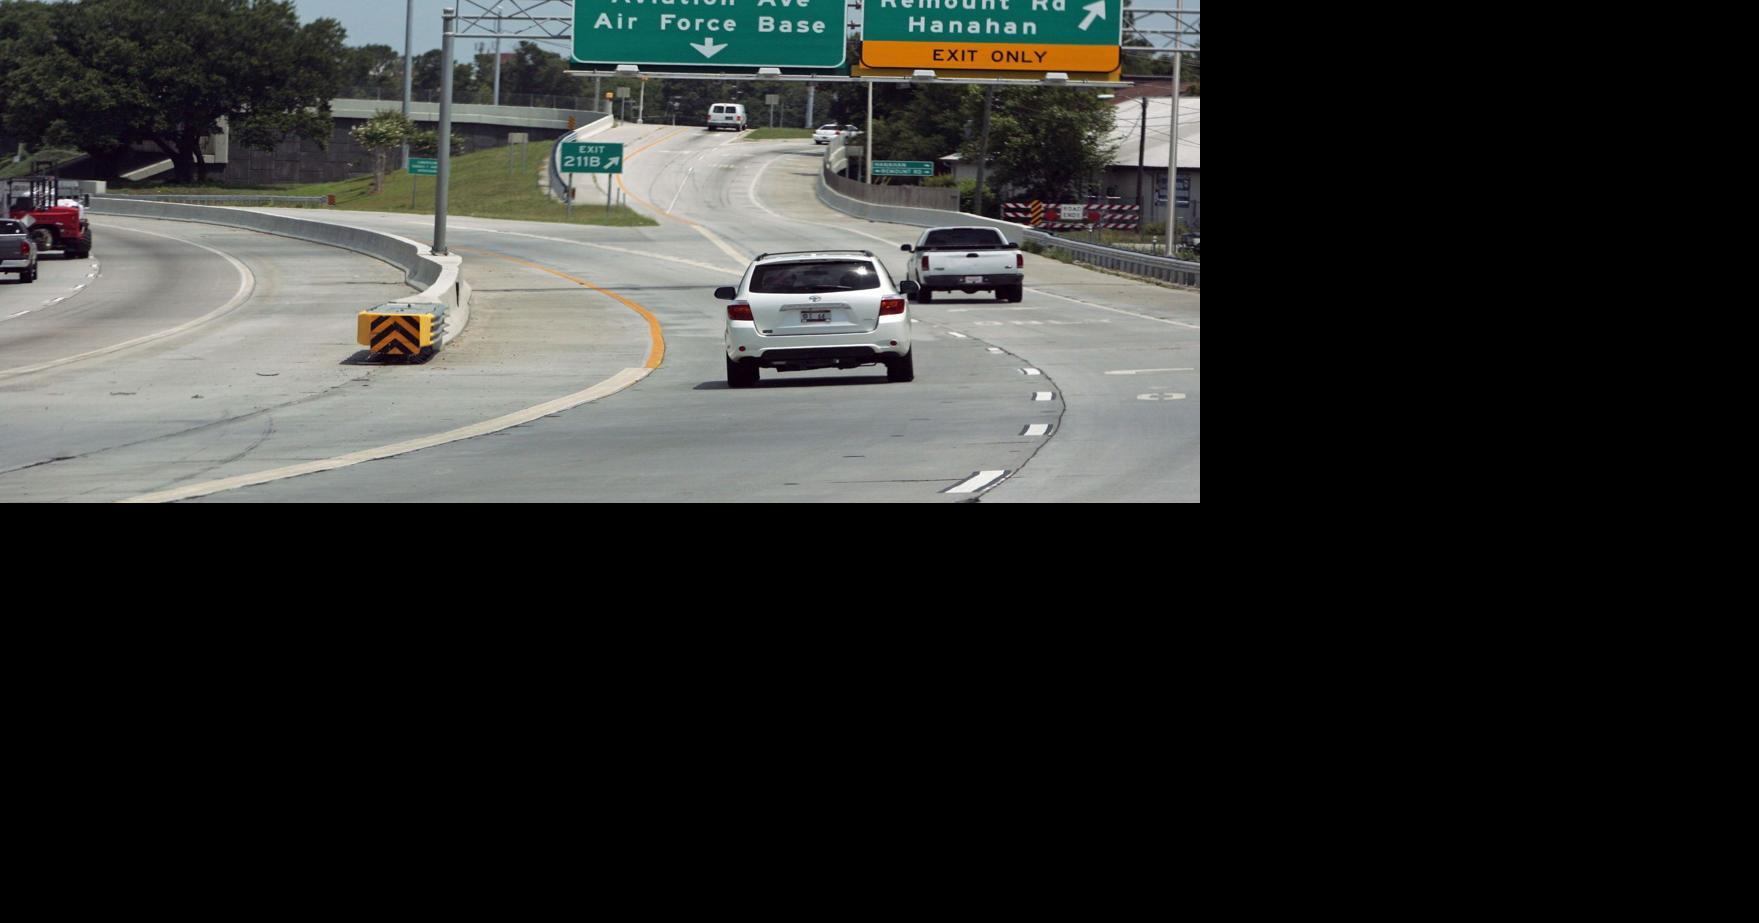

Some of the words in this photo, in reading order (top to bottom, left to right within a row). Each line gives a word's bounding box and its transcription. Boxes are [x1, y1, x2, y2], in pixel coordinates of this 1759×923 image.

[1031, 0, 1066, 11] Rd
[594, 13, 638, 29] Air
[660, 14, 737, 31] Force
[758, 16, 826, 33] Base
[908, 16, 1037, 35] Hanahan
[933, 49, 978, 62] EXIT
[991, 50, 1047, 63] ONLY
[578, 145, 605, 153] EXIT
[564, 156, 601, 167] 211B
